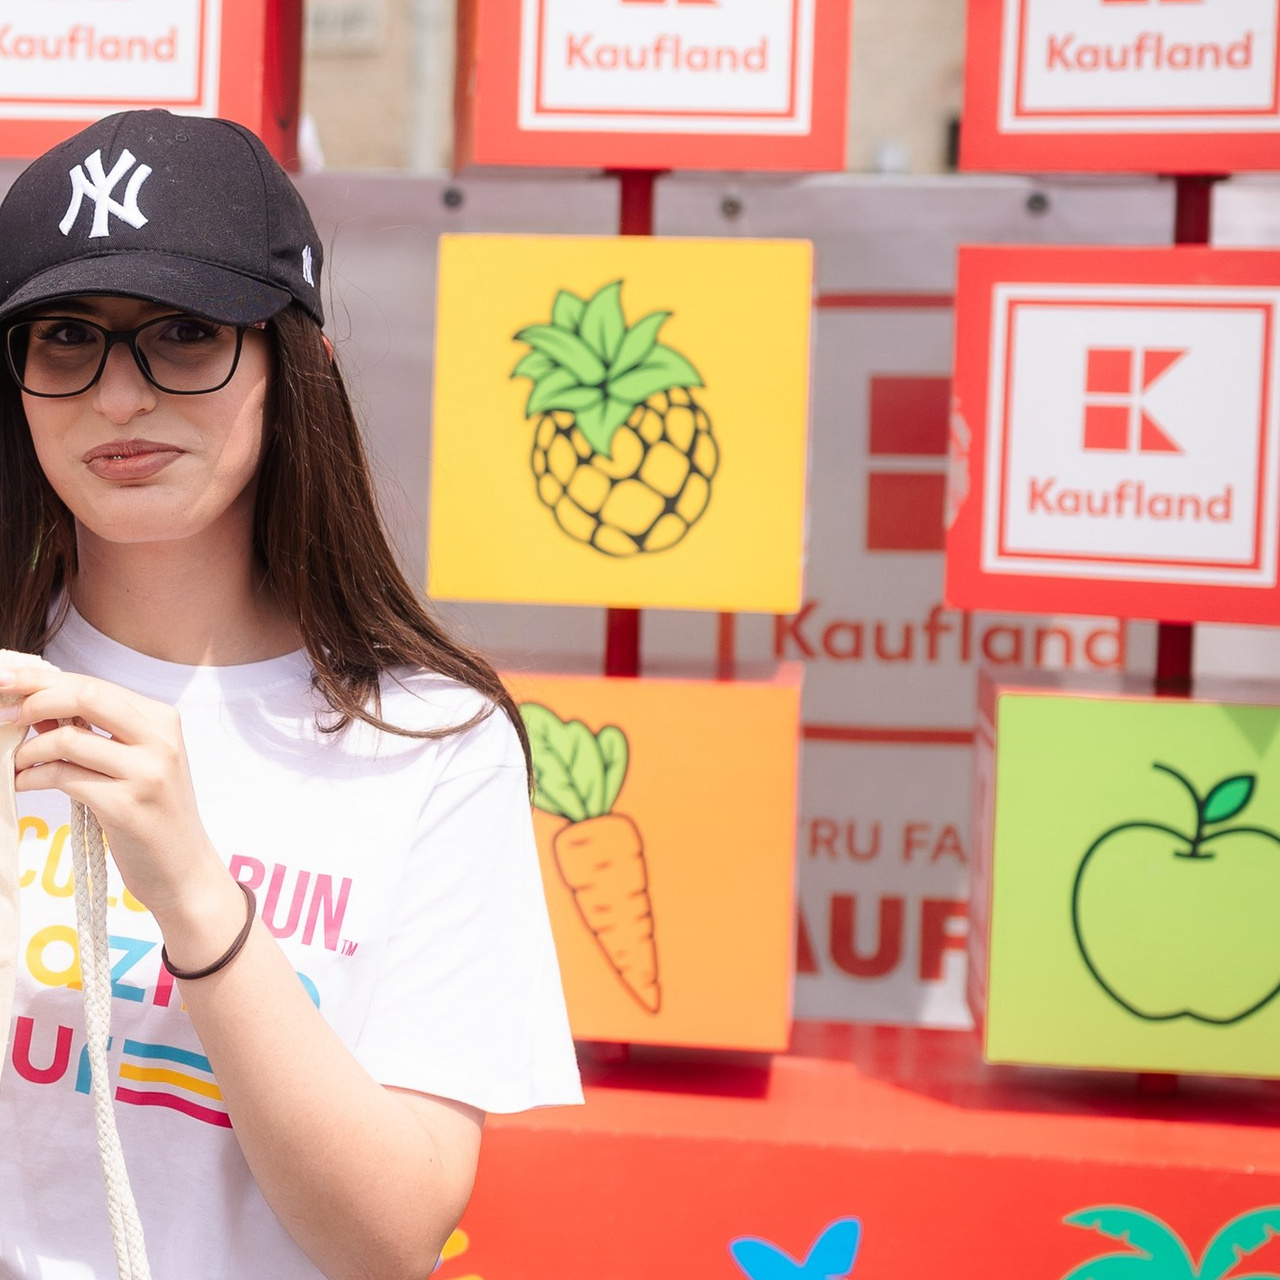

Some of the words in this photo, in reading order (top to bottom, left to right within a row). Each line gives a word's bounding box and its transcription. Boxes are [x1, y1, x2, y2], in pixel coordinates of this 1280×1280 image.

[566, 32, 769, 73] Kaufland
[1046, 30, 1254, 73] Kaufland
[1027, 477, 1234, 525] Kaufland
[772, 601, 1127, 670] Kaufland
